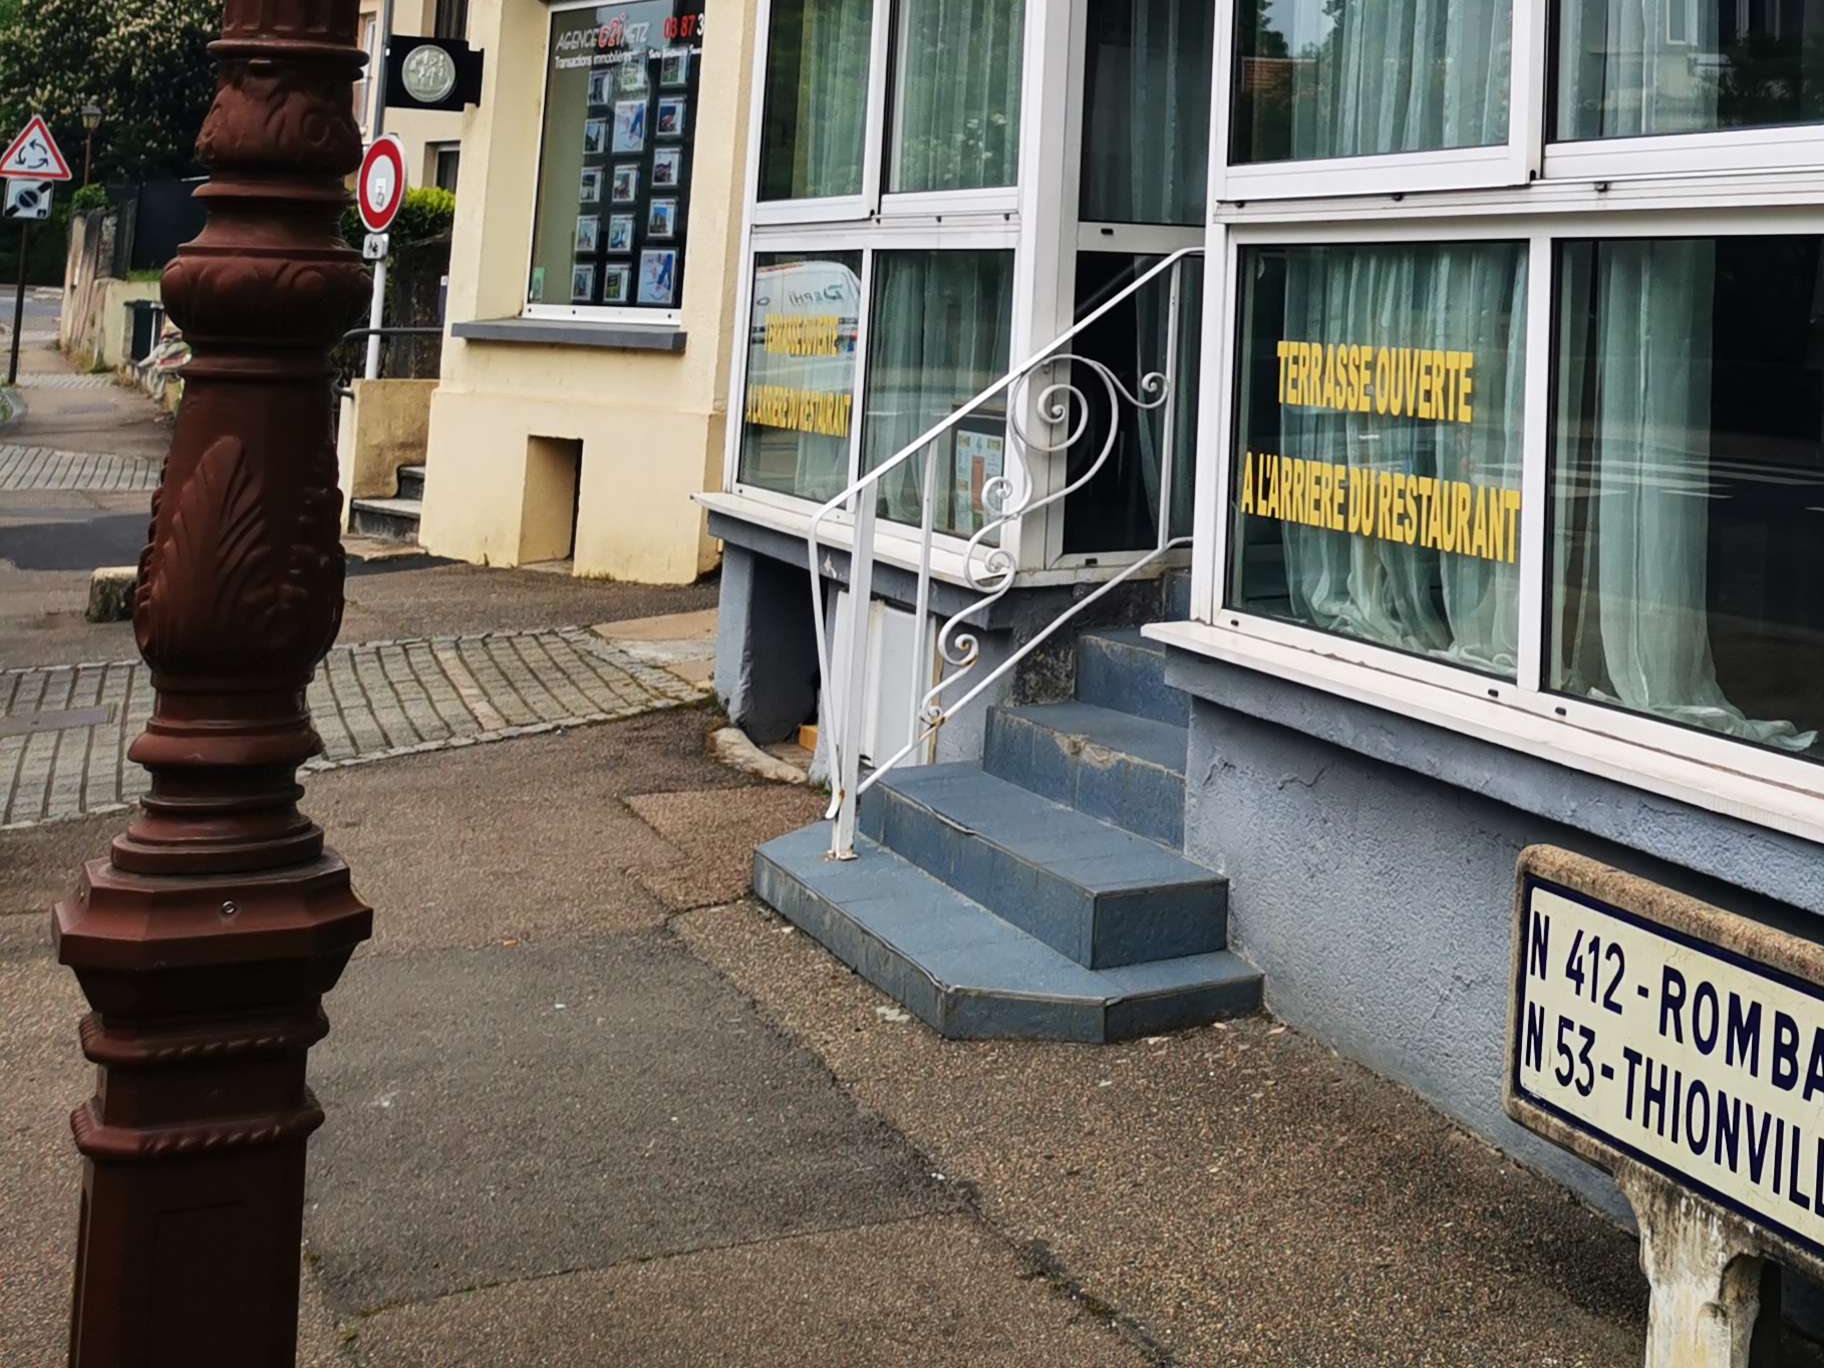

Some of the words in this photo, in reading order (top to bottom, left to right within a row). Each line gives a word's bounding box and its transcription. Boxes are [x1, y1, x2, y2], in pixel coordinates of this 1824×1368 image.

[555, 28, 600, 51] AGENCE
[664, 17, 678, 39] 03
[681, 15, 696, 37] 87
[1277, 340, 1373, 412] TERRASSE
[1375, 346, 1474, 423] OUVERTE
[1240, 451, 1254, 514] A
[1257, 453, 1346, 531] L'ARRIERE
[1348, 467, 1376, 537] DU
[1377, 471, 1521, 563] RESTAURANT
[1529, 910, 1550, 980] N
[1525, 1001, 1545, 1072] N
